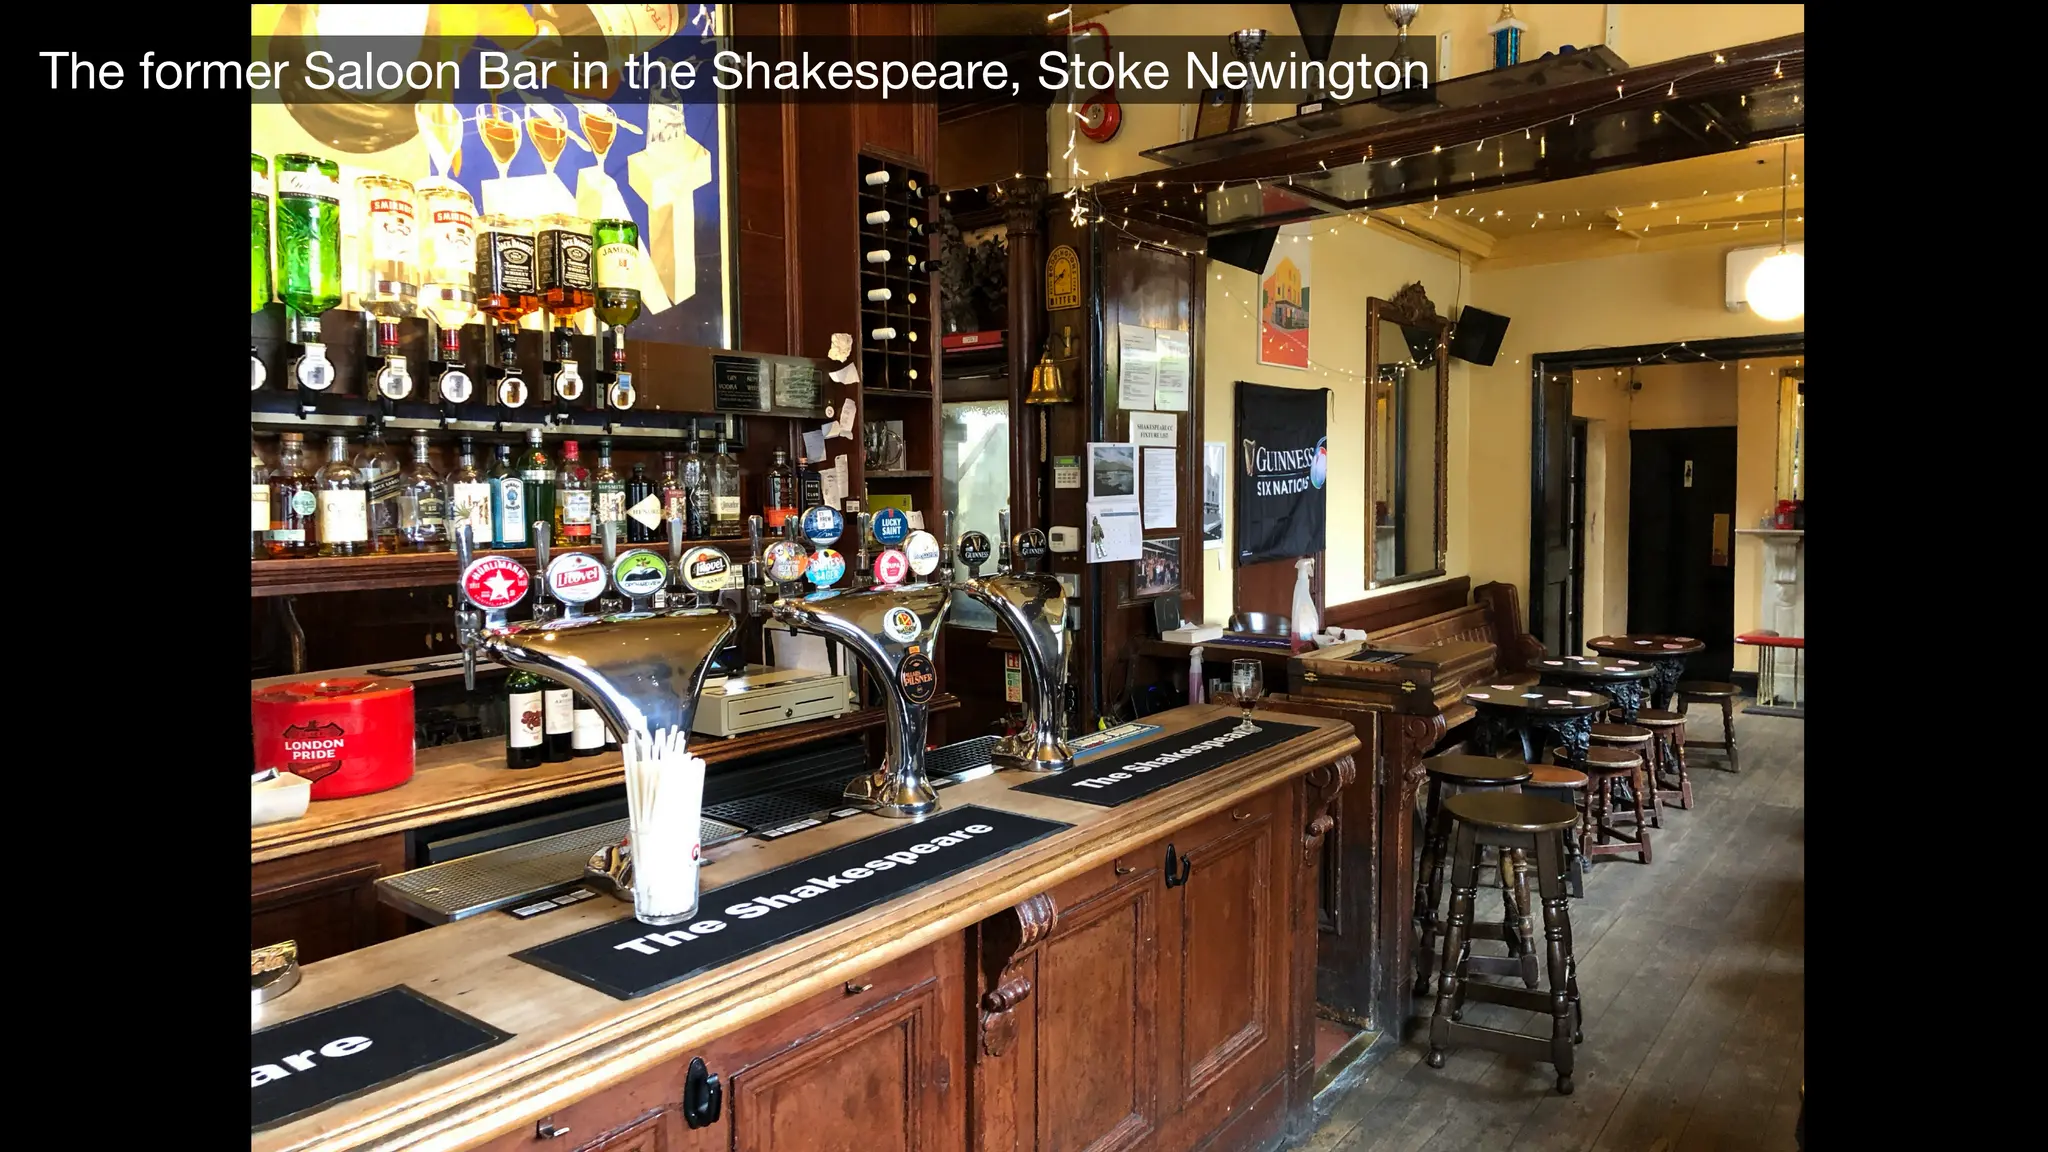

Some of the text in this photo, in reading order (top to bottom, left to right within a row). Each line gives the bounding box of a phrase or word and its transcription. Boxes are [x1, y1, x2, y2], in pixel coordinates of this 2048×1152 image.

[1050, 295, 1076, 306] BITTER
[1256, 446, 1315, 472] GUINNESS
[1257, 481, 1271, 496] SIX
[881, 518, 902, 527] LUCKY
[881, 526, 902, 536] SAINT
[964, 551, 989, 559] GUINNESS
[1022, 547, 1045, 556] GUINNESS
[559, 567, 598, 587] Litovel
[904, 673, 933, 686] PILSNER
[284, 738, 344, 751] LONDON
[292, 749, 336, 760] PRIDE
[1072, 771, 1133, 790] The
[613, 822, 994, 956] The Shakespeare
